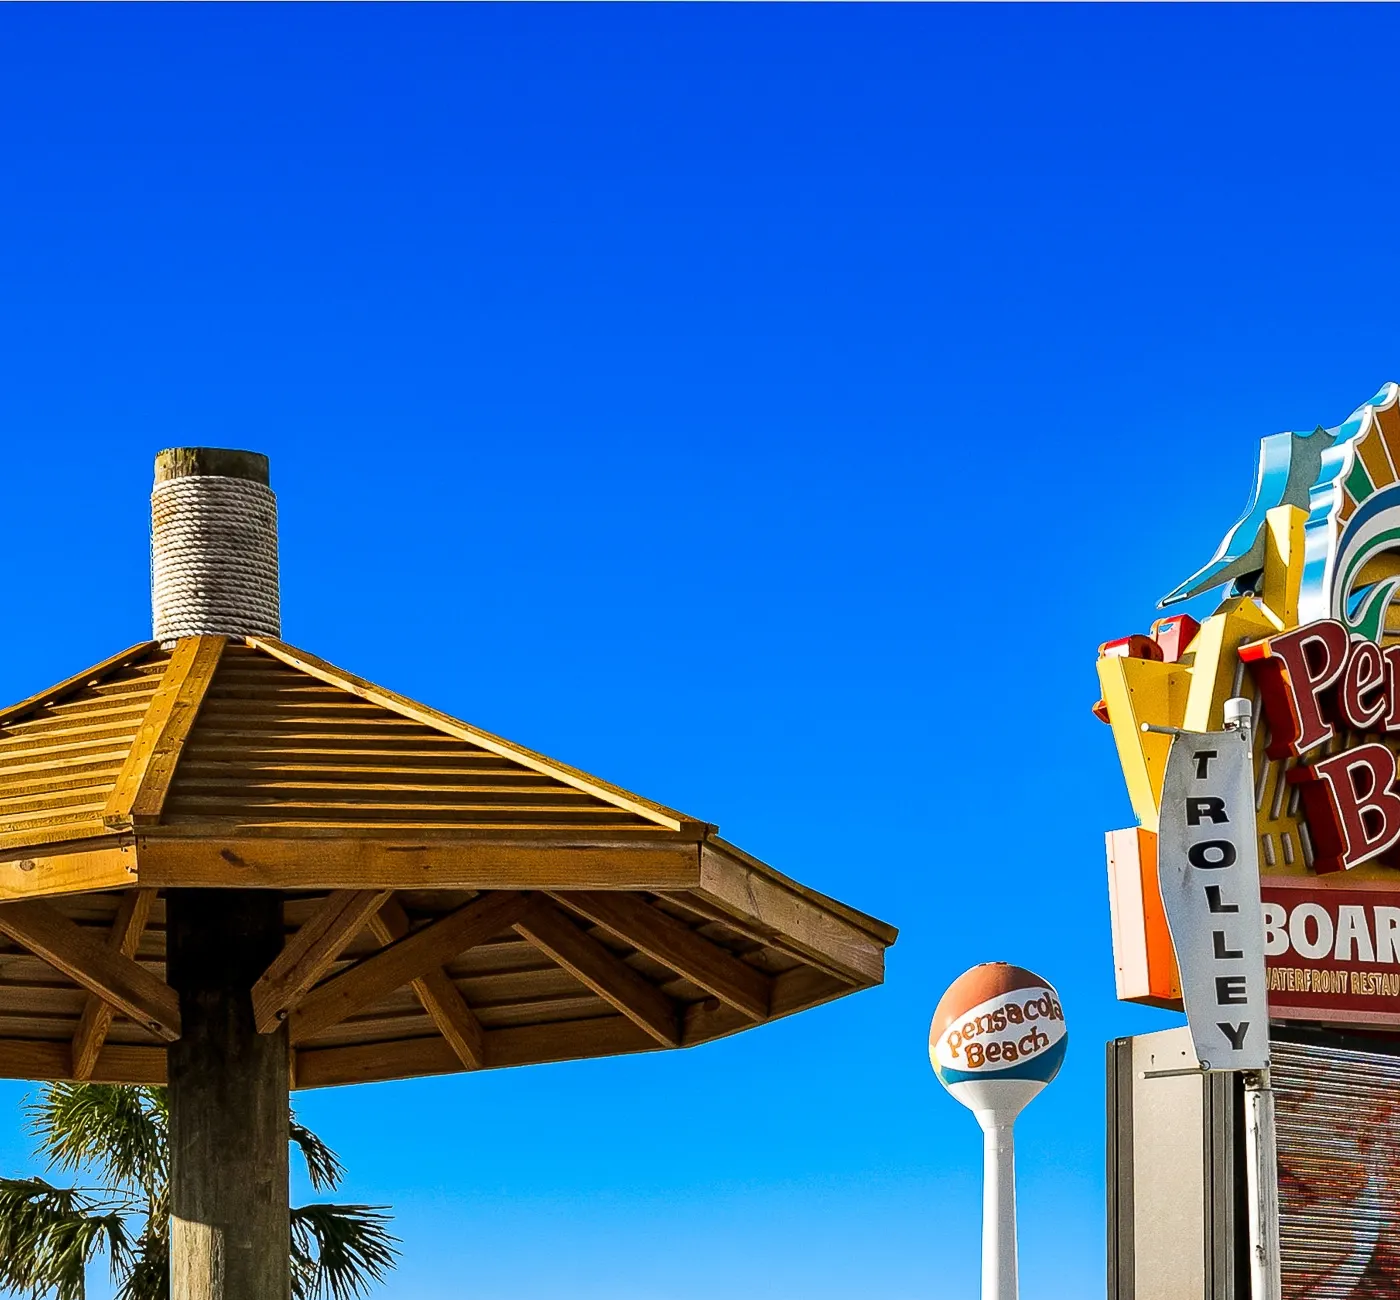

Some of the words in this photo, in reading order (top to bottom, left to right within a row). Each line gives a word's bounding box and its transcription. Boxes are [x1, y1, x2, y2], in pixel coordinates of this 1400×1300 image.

[1186, 750, 1250, 1050] TROLLEY
[947, 992, 1064, 1058] Pensacola
[964, 1026, 1050, 1069] Beach
